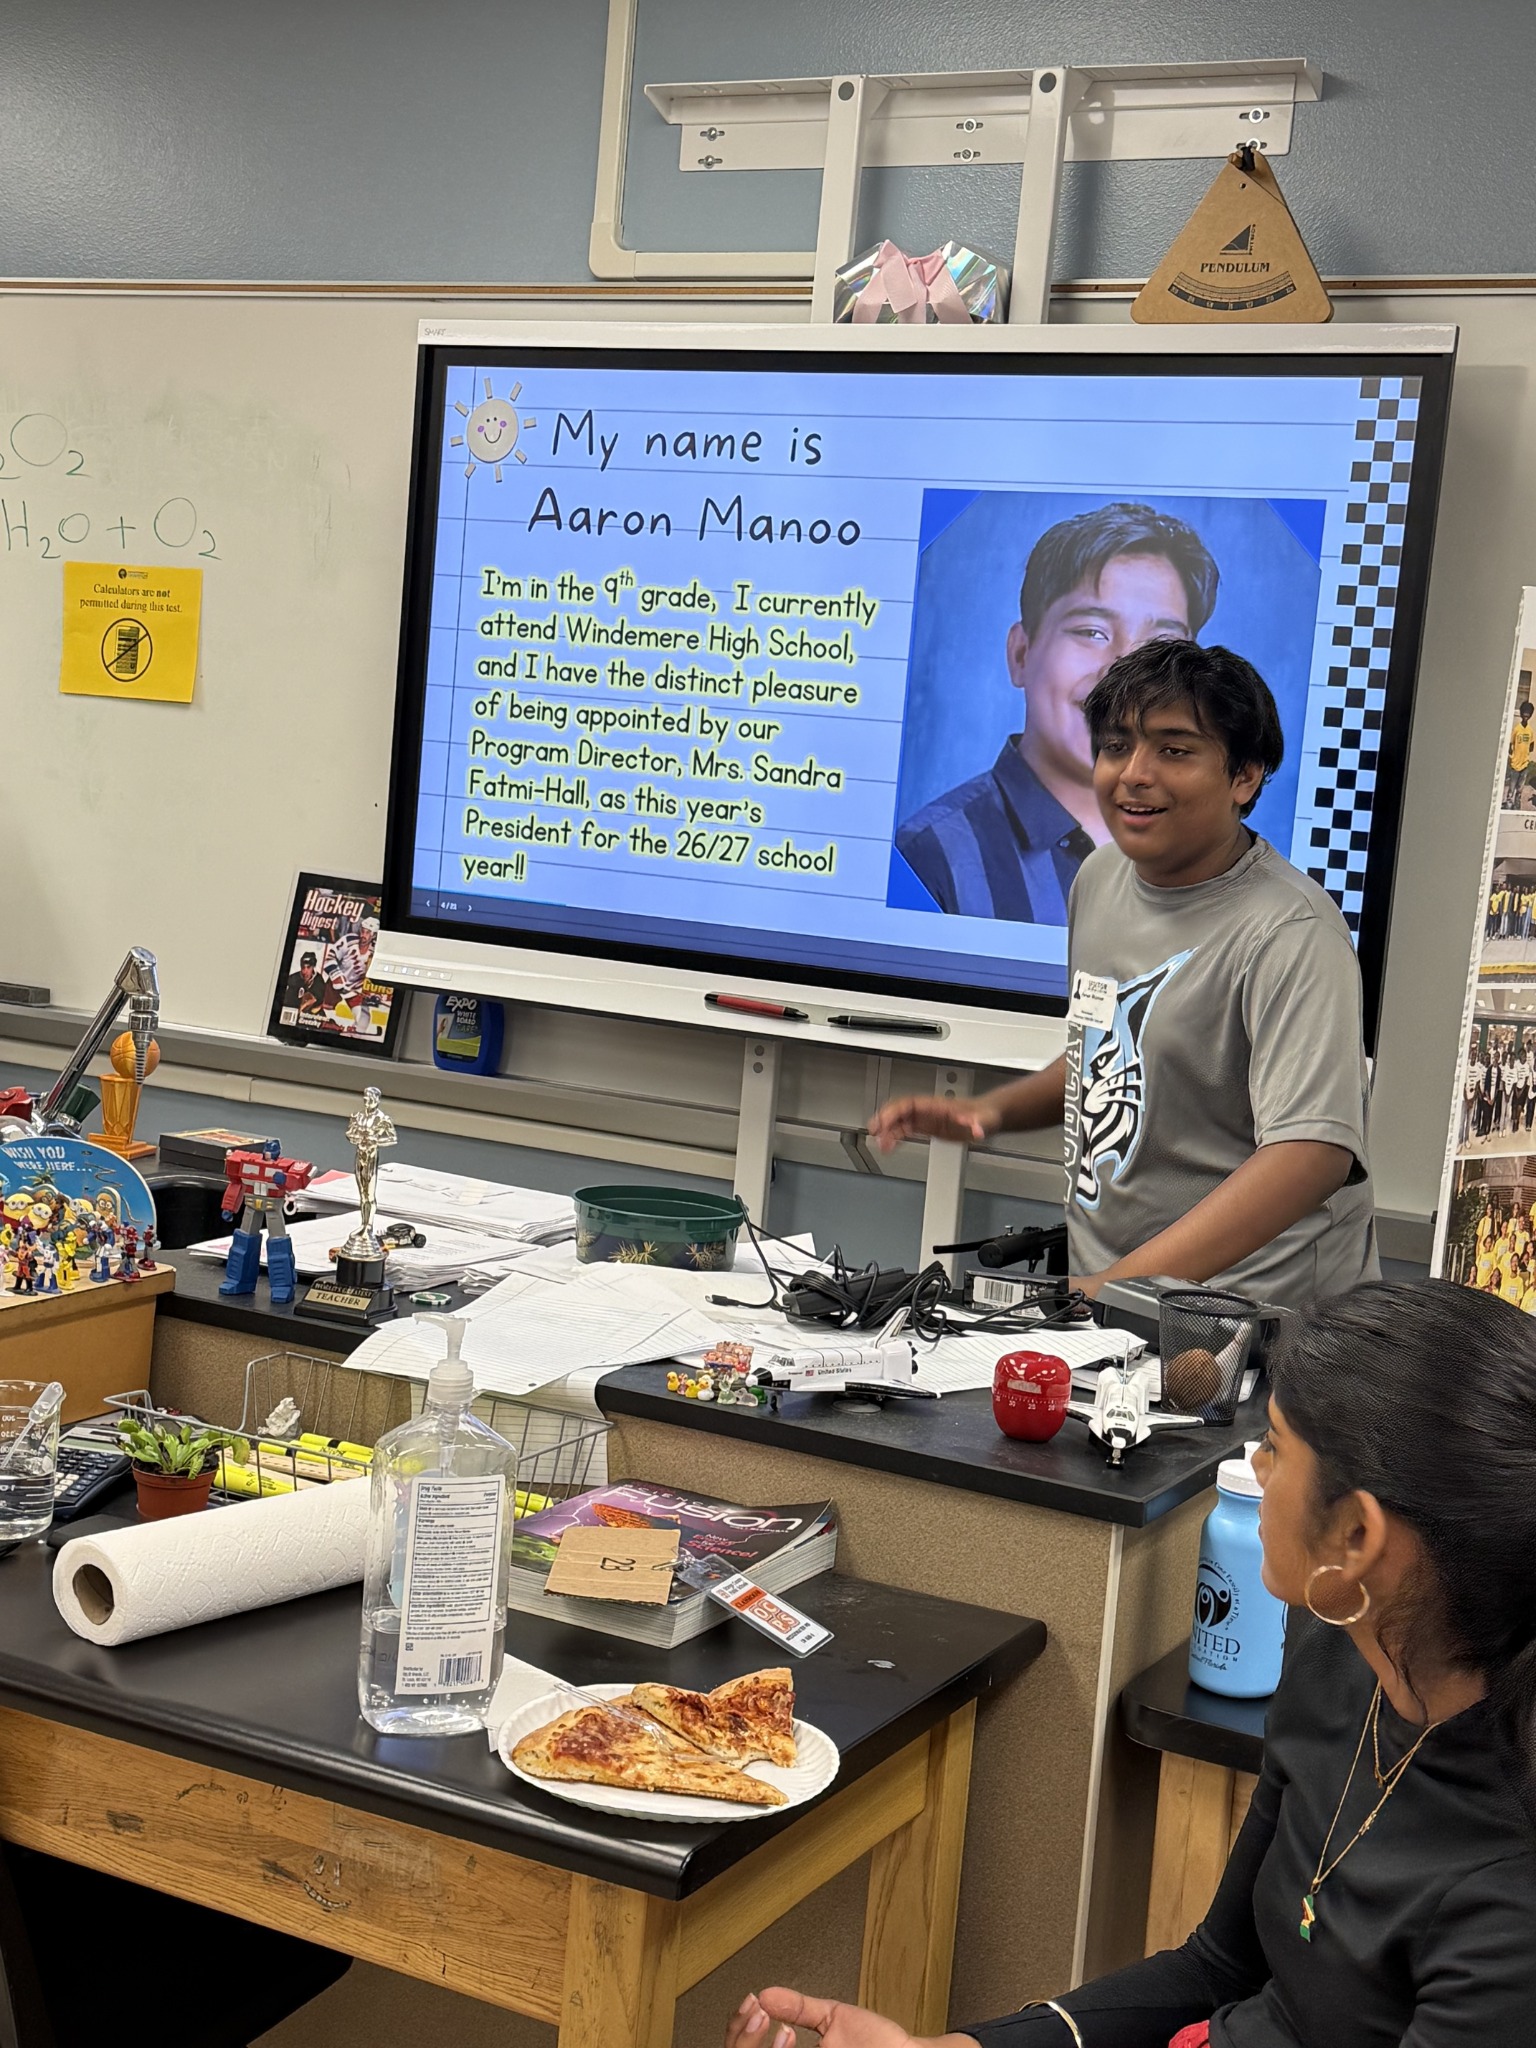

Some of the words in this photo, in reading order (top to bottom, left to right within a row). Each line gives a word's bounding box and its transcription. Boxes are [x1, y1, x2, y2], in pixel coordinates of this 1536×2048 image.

[1200, 263, 1270, 273] PENDULUM
[552, 409, 619, 471] My
[645, 430, 762, 463] name
[789, 427, 823, 466] is
[528, 487, 671, 537] Aaron
[699, 495, 861, 546] Manoo
[80, 599, 119, 609] permitted
[120, 600, 147, 613] during
[149, 601, 164, 611] this
[166, 602, 182, 613] test.
[93, 583, 140, 597] Calculators
[141, 589, 154, 597] are
[156, 589, 170, 598] not
[483, 569, 522, 599] I'm
[530, 574, 548, 599] in
[558, 575, 595, 602] the
[641, 581, 717, 613] grade,
[735, 583, 750, 611] I
[759, 590, 876, 626] currently
[480, 612, 557, 641] attend
[567, 615, 700, 648] Windemere
[709, 624, 759, 660] High
[769, 628, 854, 664] School,
[477, 651, 518, 679] and
[524, 653, 539, 679] I
[546, 654, 598, 684] have
[608, 660, 645, 688] the
[654, 663, 744, 696] distinct
[752, 670, 858, 705] pleasure
[474, 692, 502, 718] of
[509, 693, 568, 730] being
[576, 707, 690, 741] appointed
[700, 708, 728, 743] by
[738, 719, 780, 741] our
[470, 730, 570, 768] Program
[578, 739, 683, 779] Director,
[692, 751, 744, 782] Mrs.
[753, 754, 842, 790] Sandra
[469, 769, 590, 810] Fatmi-Hall,
[599, 790, 626, 811] as
[634, 786, 678, 816] this
[686, 799, 763, 824] year's
[1524, 819, 1536, 830] CE
[464, 808, 572, 846] President
[580, 821, 620, 852] for
[629, 827, 668, 856] the
[676, 832, 750, 863] 26/27
[757, 841, 836, 874] school
[463, 853, 526, 882] year!!
[300, 911, 338, 931] Digest
[303, 889, 365, 923] Hockey
[445, 995, 478, 1013] EXPO
[0, 1146, 37, 1159] WISH
[37, 1145, 66, 1159] YOU
[315, 1292, 361, 1306] TEACHER
[600, 1557, 636, 1571] 23
